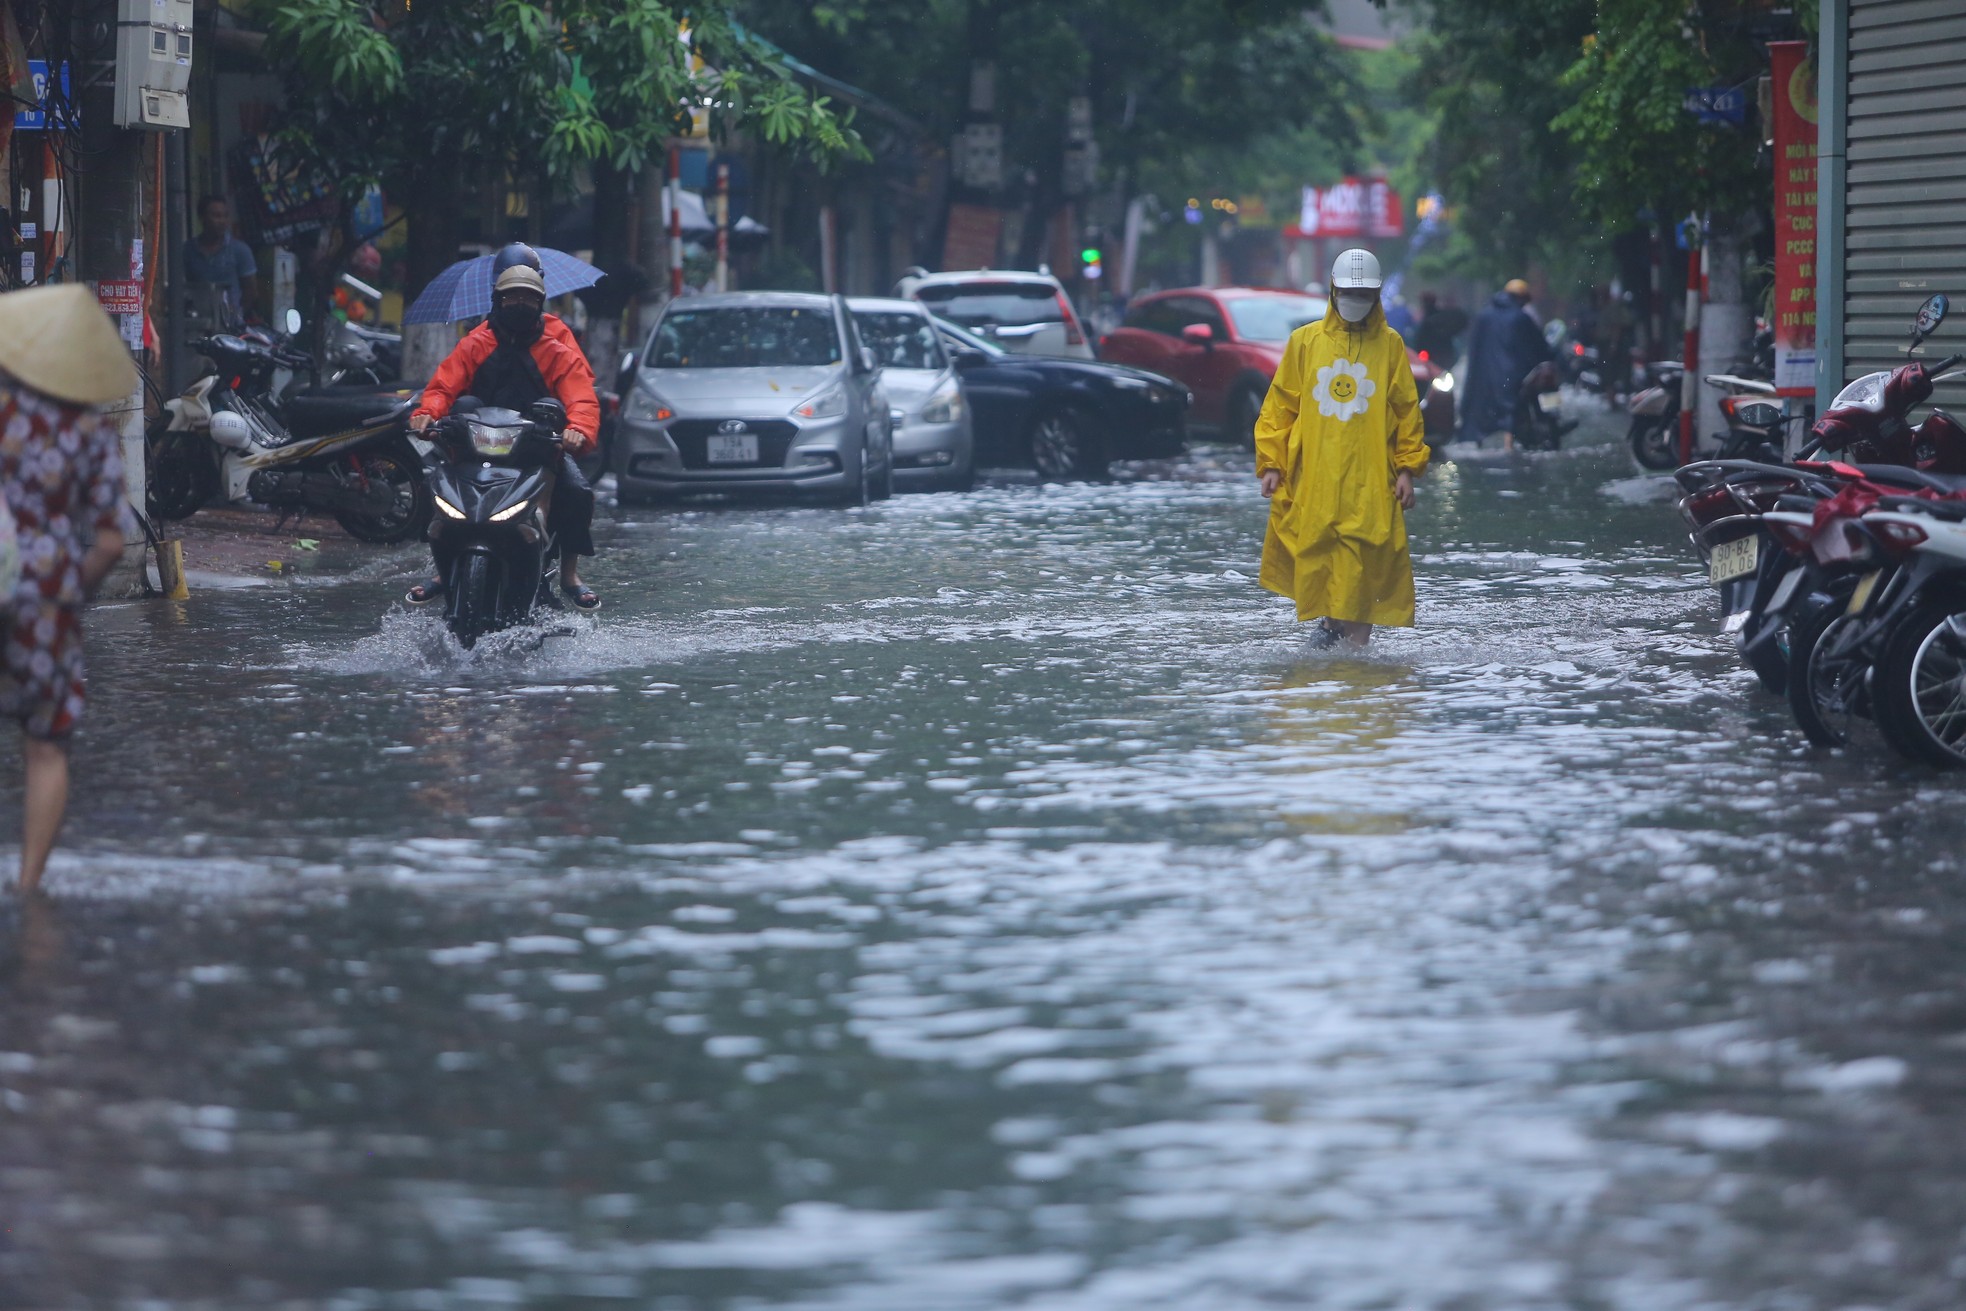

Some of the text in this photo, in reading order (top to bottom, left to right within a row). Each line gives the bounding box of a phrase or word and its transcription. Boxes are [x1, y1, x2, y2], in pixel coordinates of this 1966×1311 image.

[1786, 239, 1814, 255] PCCC
[1790, 287, 1810, 302] APP
[1782, 312, 1800, 327] 114
[1718, 538, 1750, 562] 90-B2
[1712, 554, 1754, 580] 804.06
